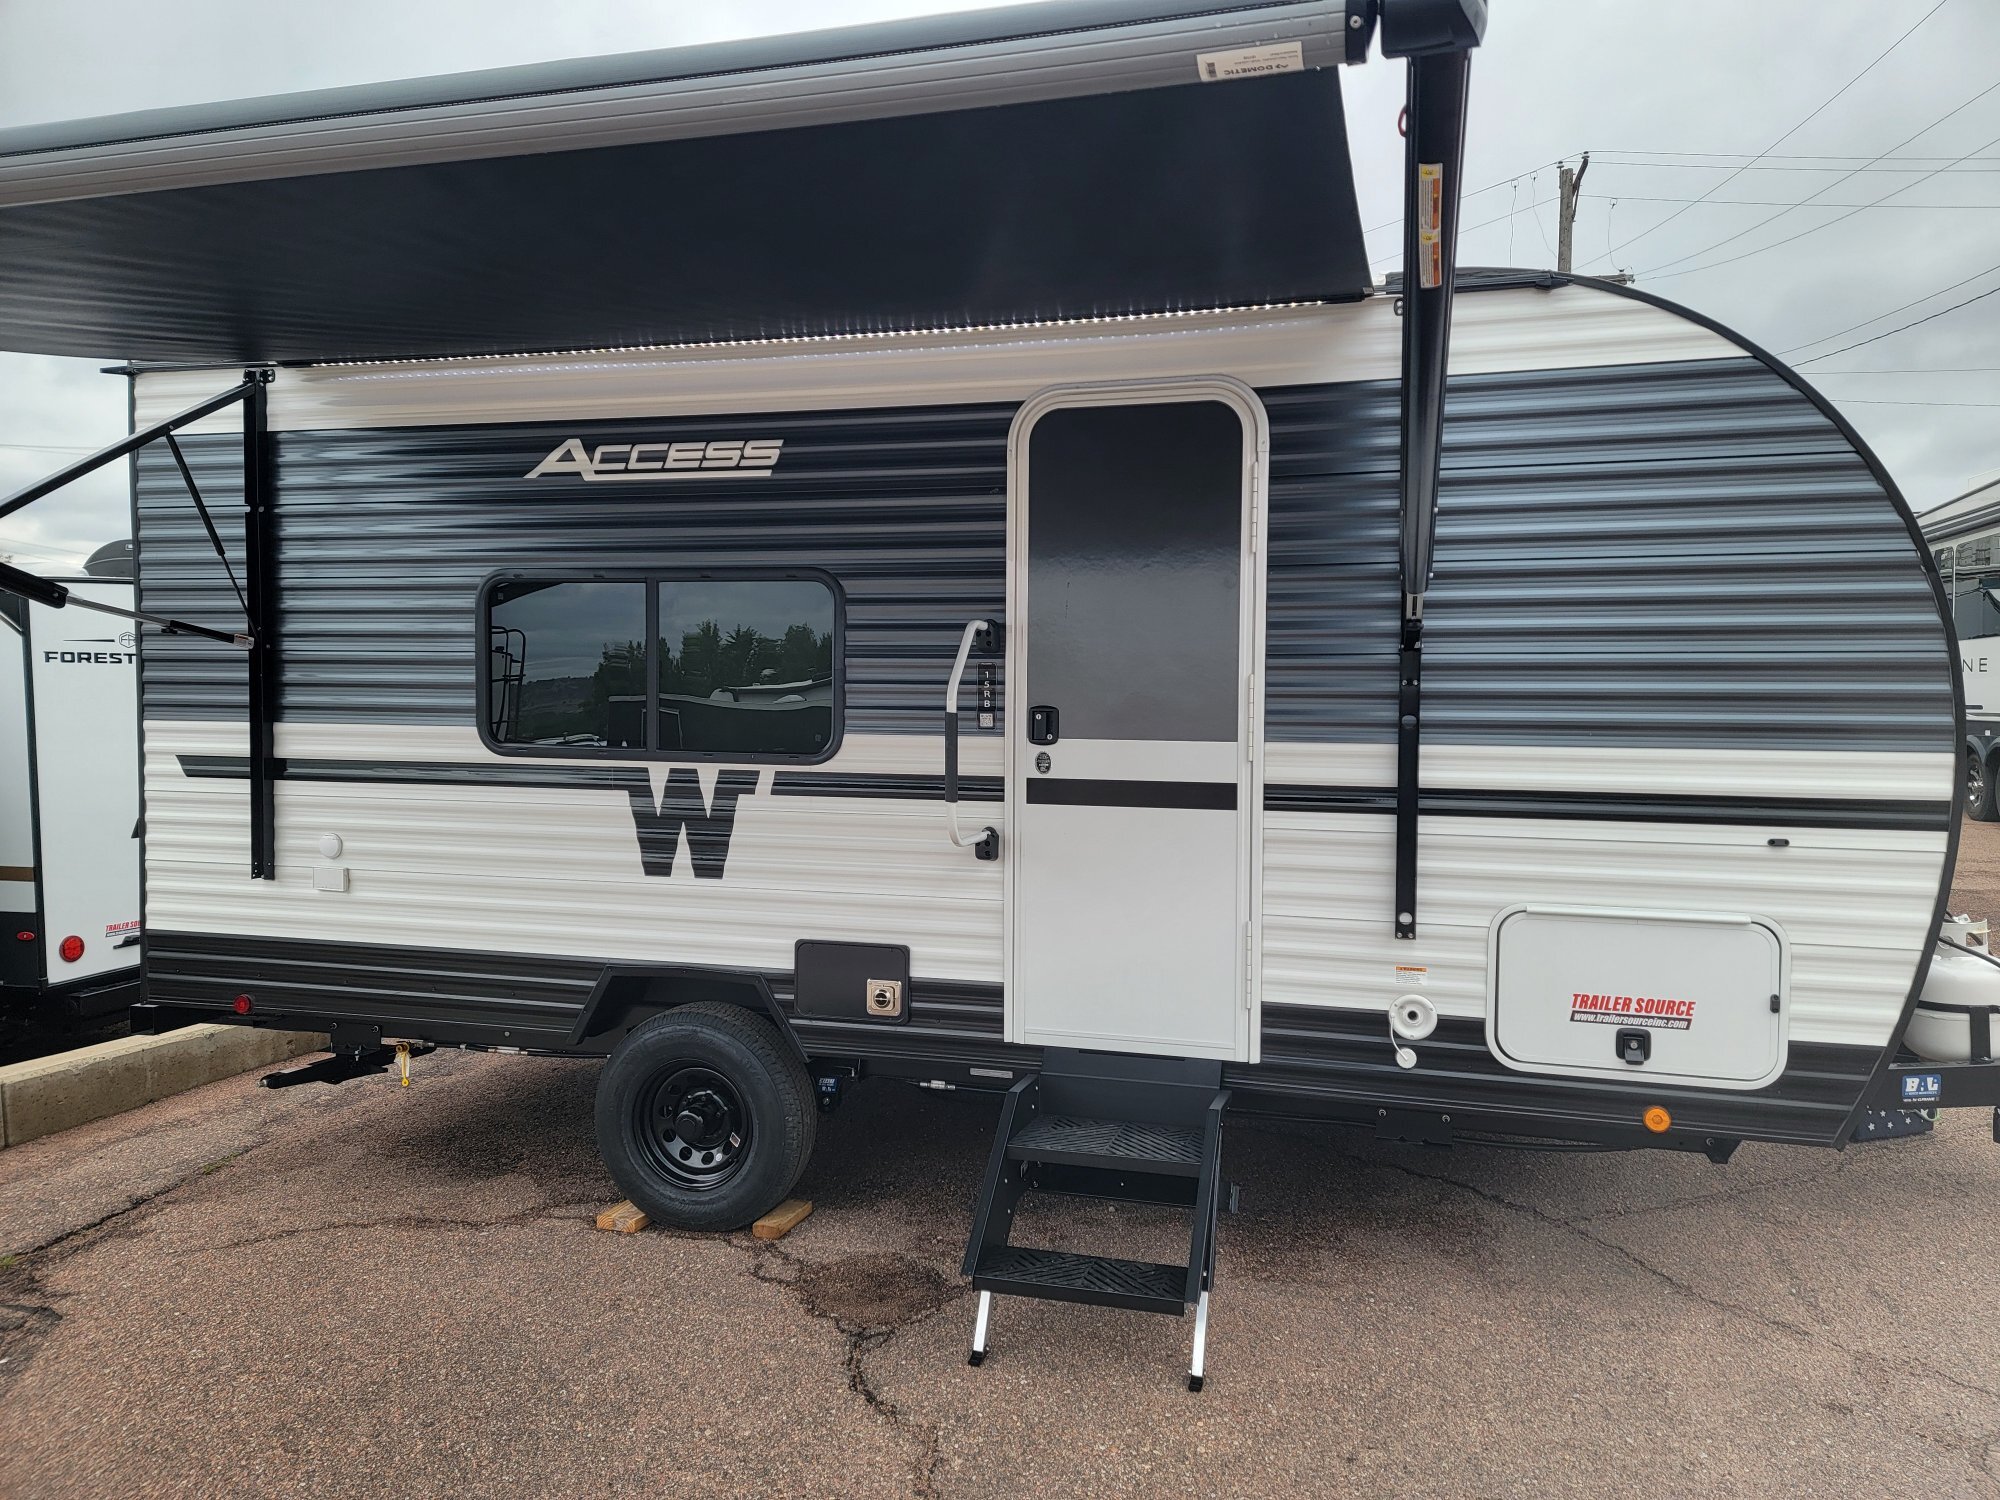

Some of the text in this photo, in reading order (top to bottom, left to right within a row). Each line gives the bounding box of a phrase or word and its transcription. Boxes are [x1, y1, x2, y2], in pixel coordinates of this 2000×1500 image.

[1224, 64, 1273, 76] DOMETIC
[43, 651, 136, 664] FOREST
[628, 767, 760, 879] W
[106, 922, 129, 932] TRAILER
[1572, 994, 1696, 1017] TRAILER SOURCE
[1573, 1012, 1688, 1029] www.trailersourceinc.com
